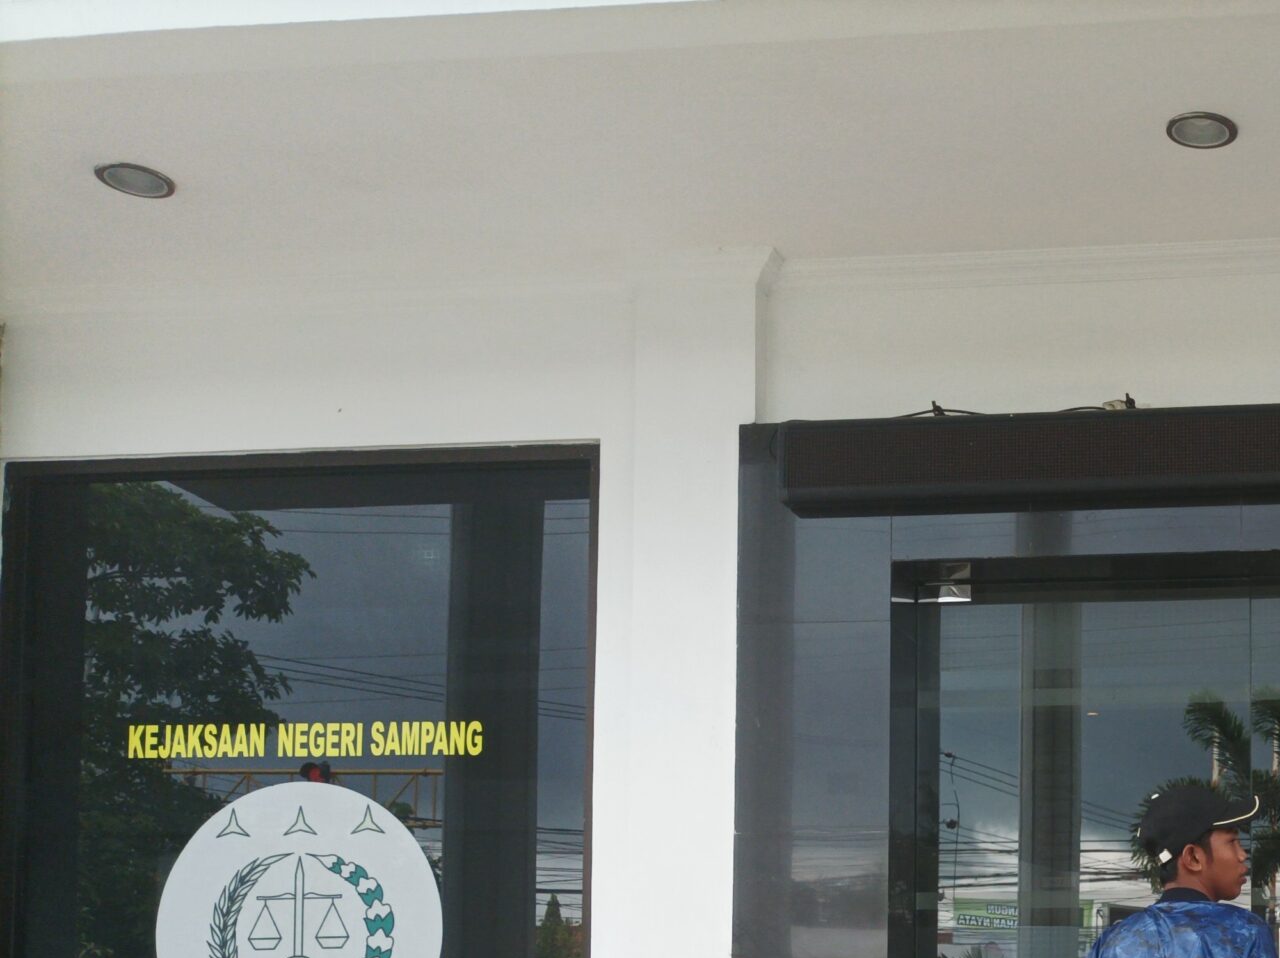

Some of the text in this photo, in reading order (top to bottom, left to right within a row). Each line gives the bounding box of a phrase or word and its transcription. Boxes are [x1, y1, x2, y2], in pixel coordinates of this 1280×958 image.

[128, 720, 484, 760] KEJAKSAAN NEGERI SAMPANG
